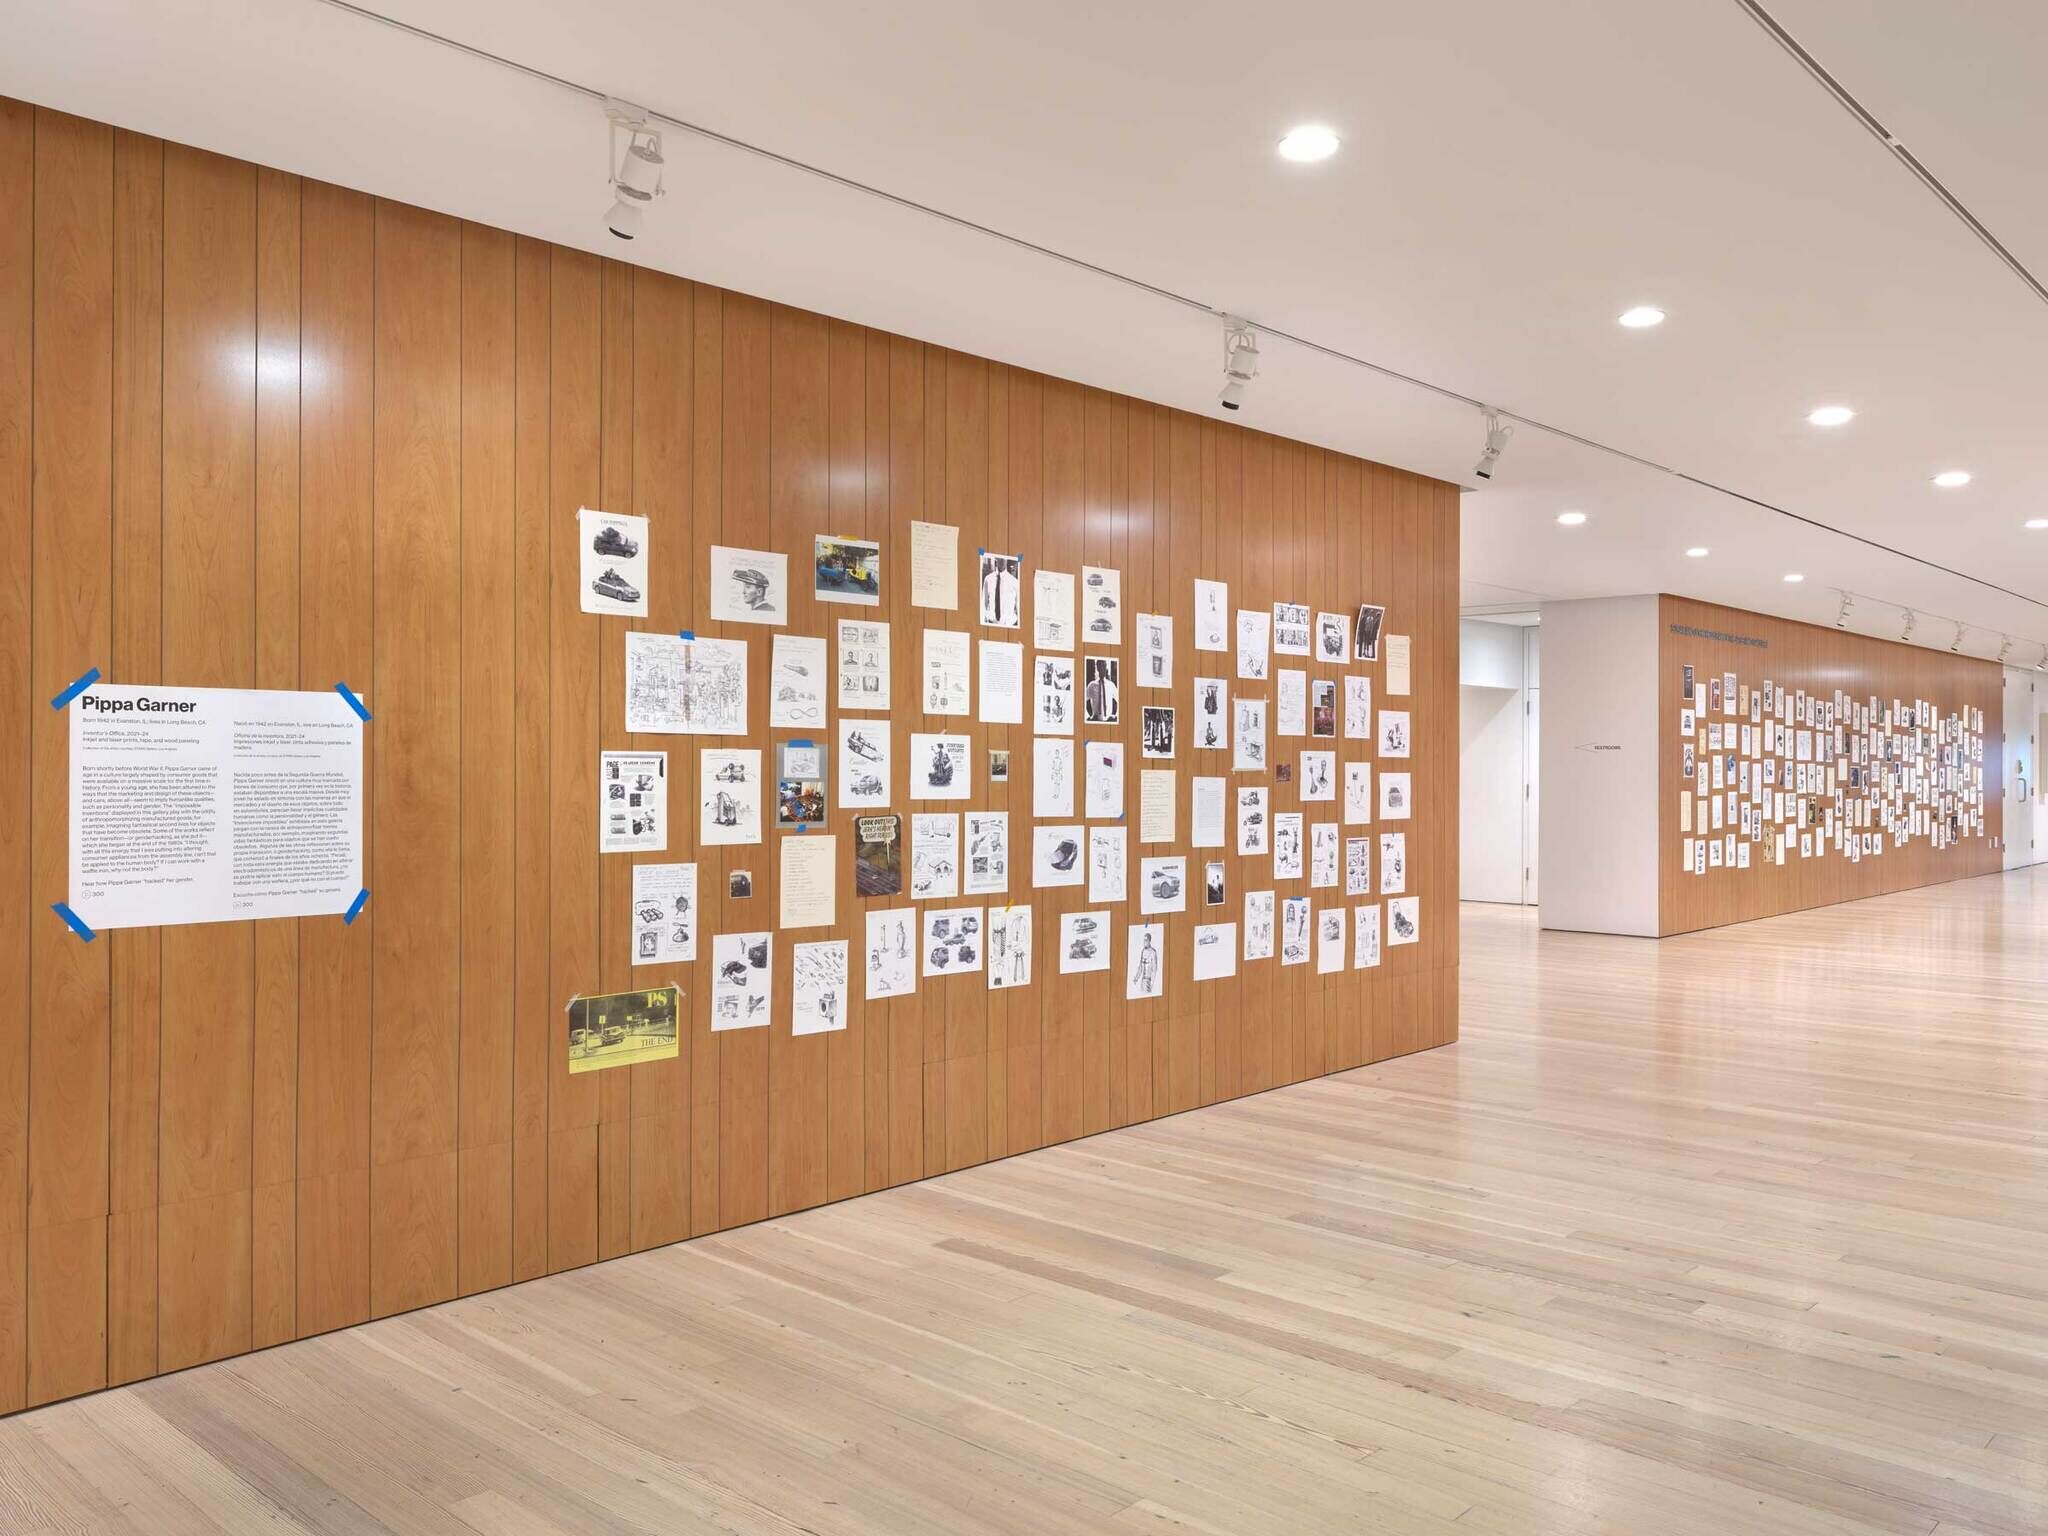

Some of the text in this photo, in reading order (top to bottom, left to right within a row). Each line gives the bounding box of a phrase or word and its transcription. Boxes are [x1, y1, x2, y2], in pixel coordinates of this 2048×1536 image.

[82, 696, 196, 713] Pippa Garner
[647, 991, 667, 1008] PS
[641, 1036, 674, 1047] THE END
